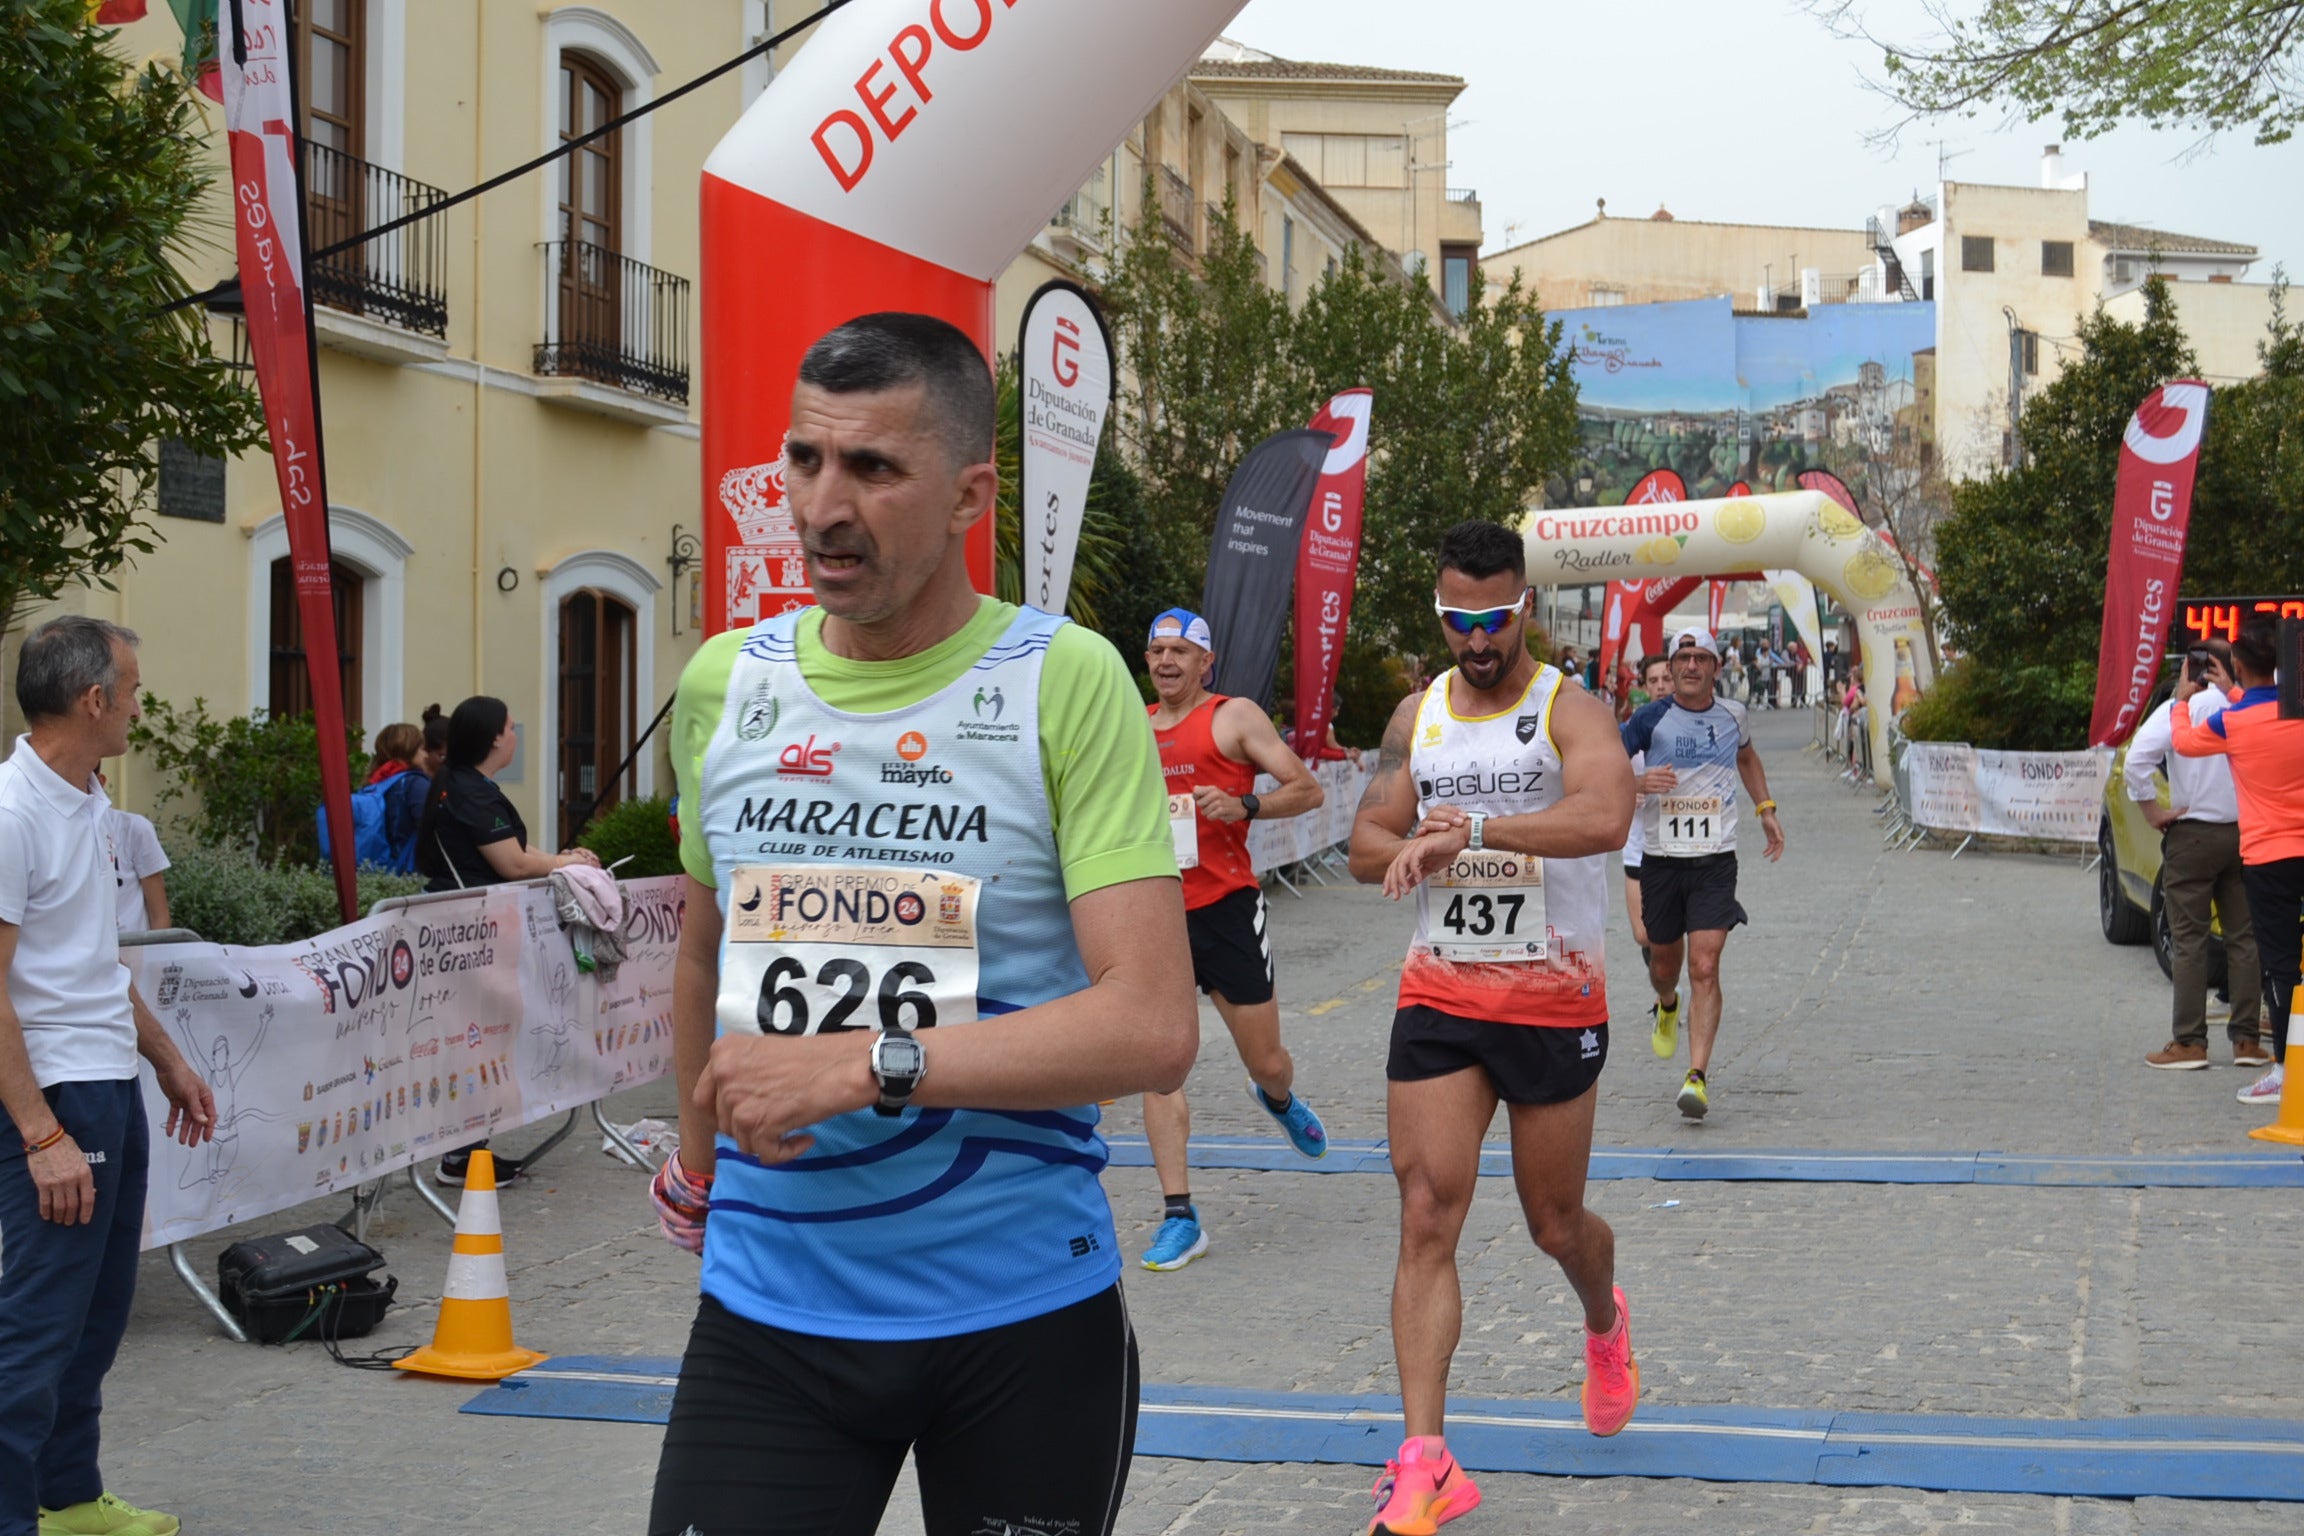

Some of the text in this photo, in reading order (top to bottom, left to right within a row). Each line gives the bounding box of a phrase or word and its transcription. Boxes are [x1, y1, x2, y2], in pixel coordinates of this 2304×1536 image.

[810, 0, 1018, 193] DEPO
[1029, 377, 1096, 423] Diputación
[1028, 405, 1095, 447] de Granada
[1235, 505, 1293, 528] Movement
[1537, 511, 1699, 541] Cruzcampo
[1232, 522, 1255, 537] that
[2132, 532, 2144, 543] de
[2133, 517, 2183, 540] Diputación
[1227, 538, 1269, 556] inspires
[1310, 530, 1353, 549] Diputación
[1319, 545, 1352, 562] Granad
[1554, 548, 1632, 572] Radler
[1867, 606, 1920, 621] Cruzcam
[2186, 605, 2238, 644] 44
[957, 720, 1020, 731] Ayuntamiento
[966, 731, 1018, 741] Maracena
[1675, 736, 1697, 748] RUN
[1675, 748, 1697, 760] CLUB
[881, 765, 954, 788] mayfo
[1163, 763, 1195, 777] DALUS
[1671, 800, 1709, 812] FONDO
[735, 797, 988, 843] MARACENA
[1668, 817, 1709, 838] 111
[759, 841, 954, 864] CLUB DE ATLETISMO
[1448, 861, 1518, 878] FONDO
[780, 874, 829, 890] GRAN
[834, 875, 898, 893] PREMIO
[778, 887, 925, 926] FONDO
[899, 901, 920, 916] 24
[1444, 894, 1525, 936] 437
[418, 916, 498, 954] Diputación
[300, 946, 353, 971] GRAN
[420, 946, 494, 977] de Granada
[184, 977, 230, 989] Diputación
[180, 989, 228, 1002] de Granada
[757, 957, 937, 1036] 626
[84, 1151, 106, 1164] ma
